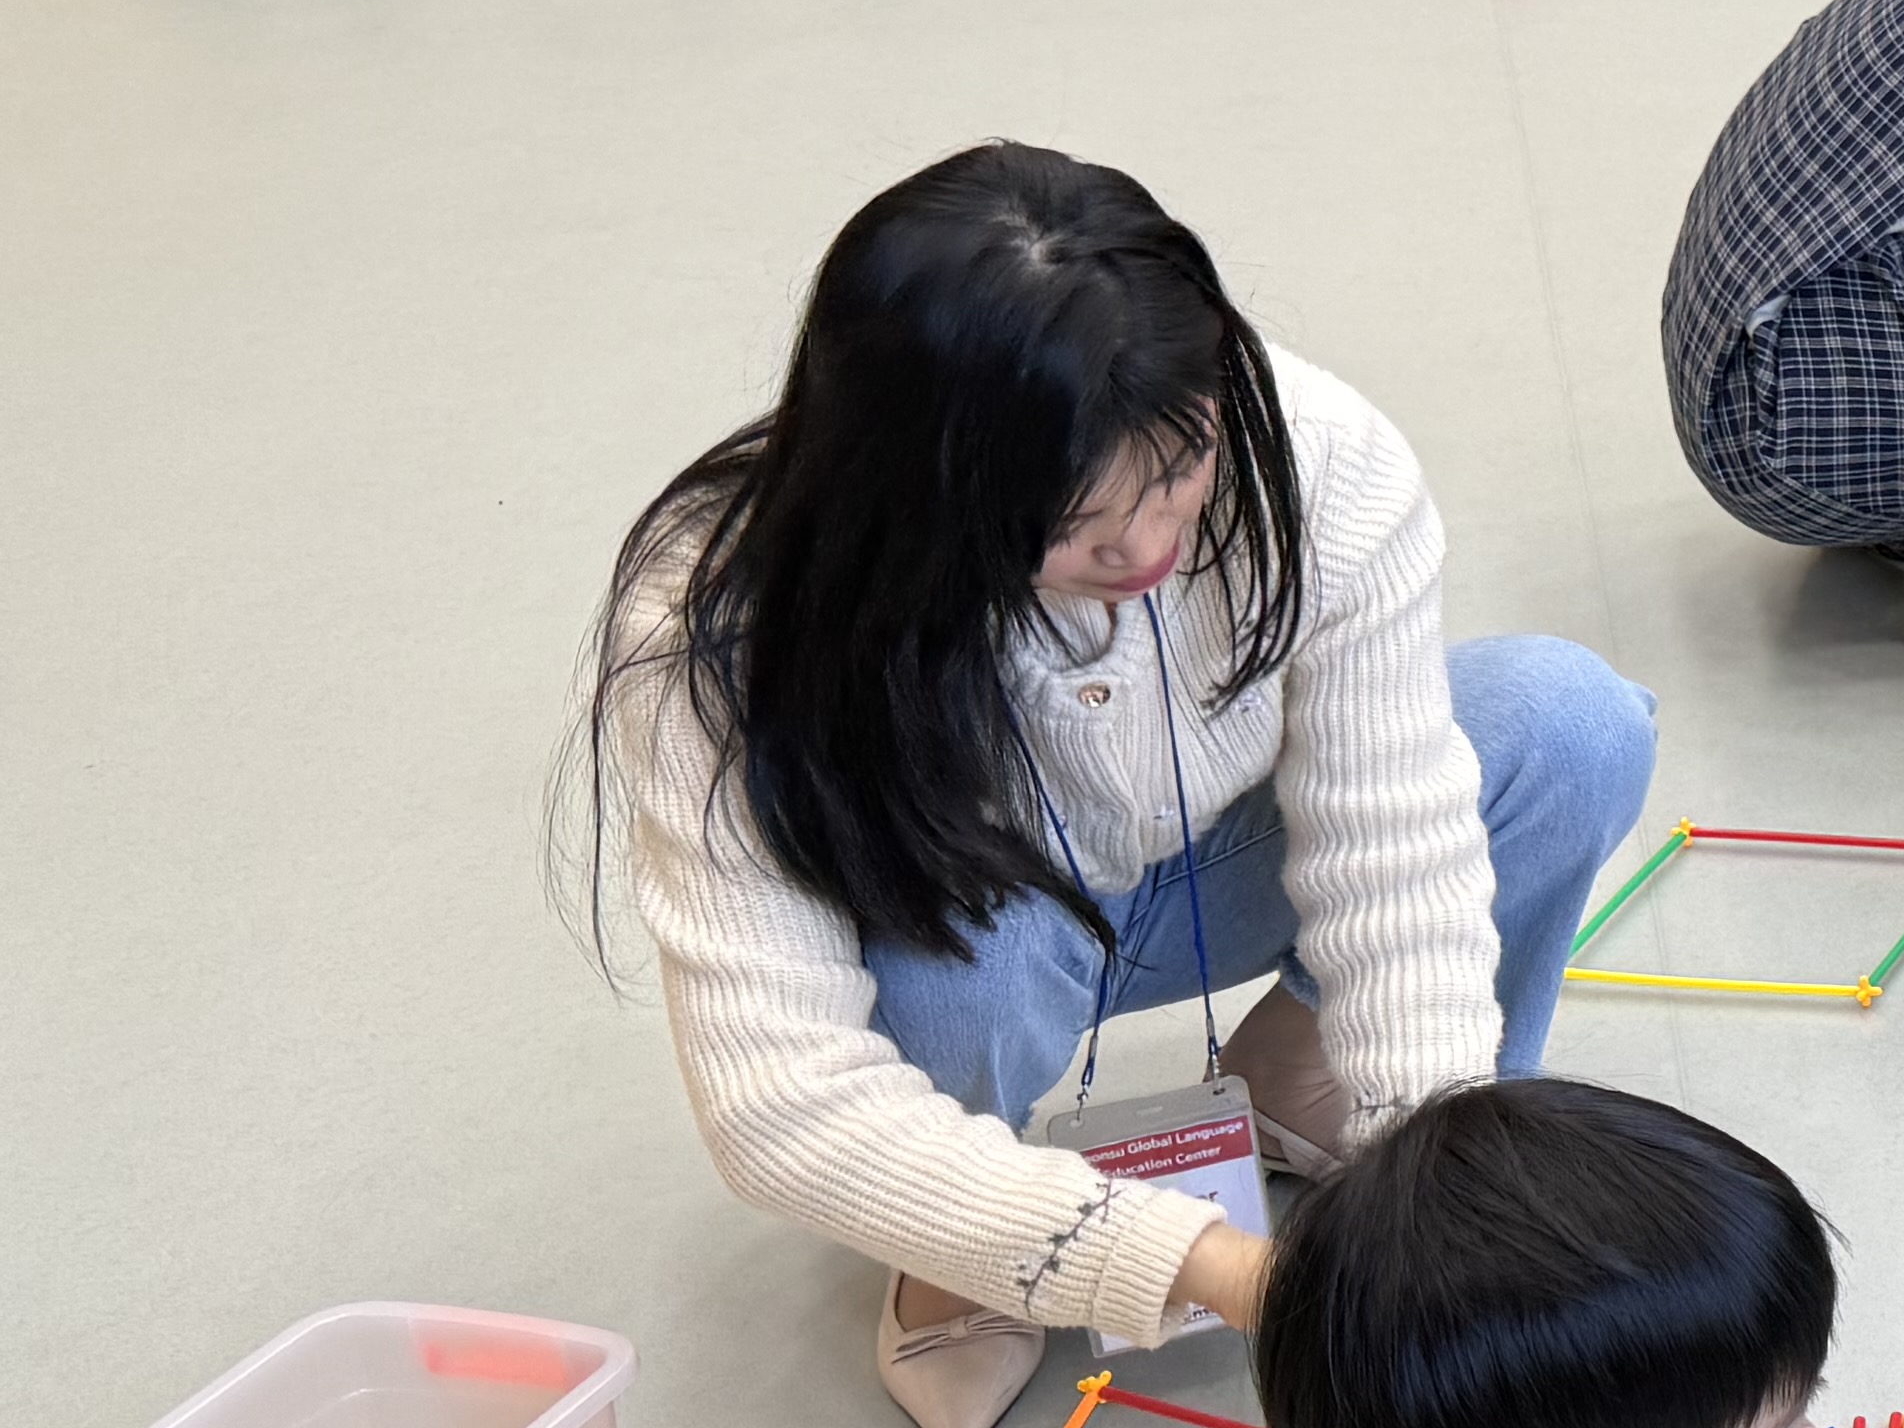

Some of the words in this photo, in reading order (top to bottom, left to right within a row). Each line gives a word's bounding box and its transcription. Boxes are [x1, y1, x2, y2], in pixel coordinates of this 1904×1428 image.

[1127, 1135, 1173, 1154] Global
[1175, 1120, 1244, 1144] Language
[1175, 1145, 1222, 1165] Center
